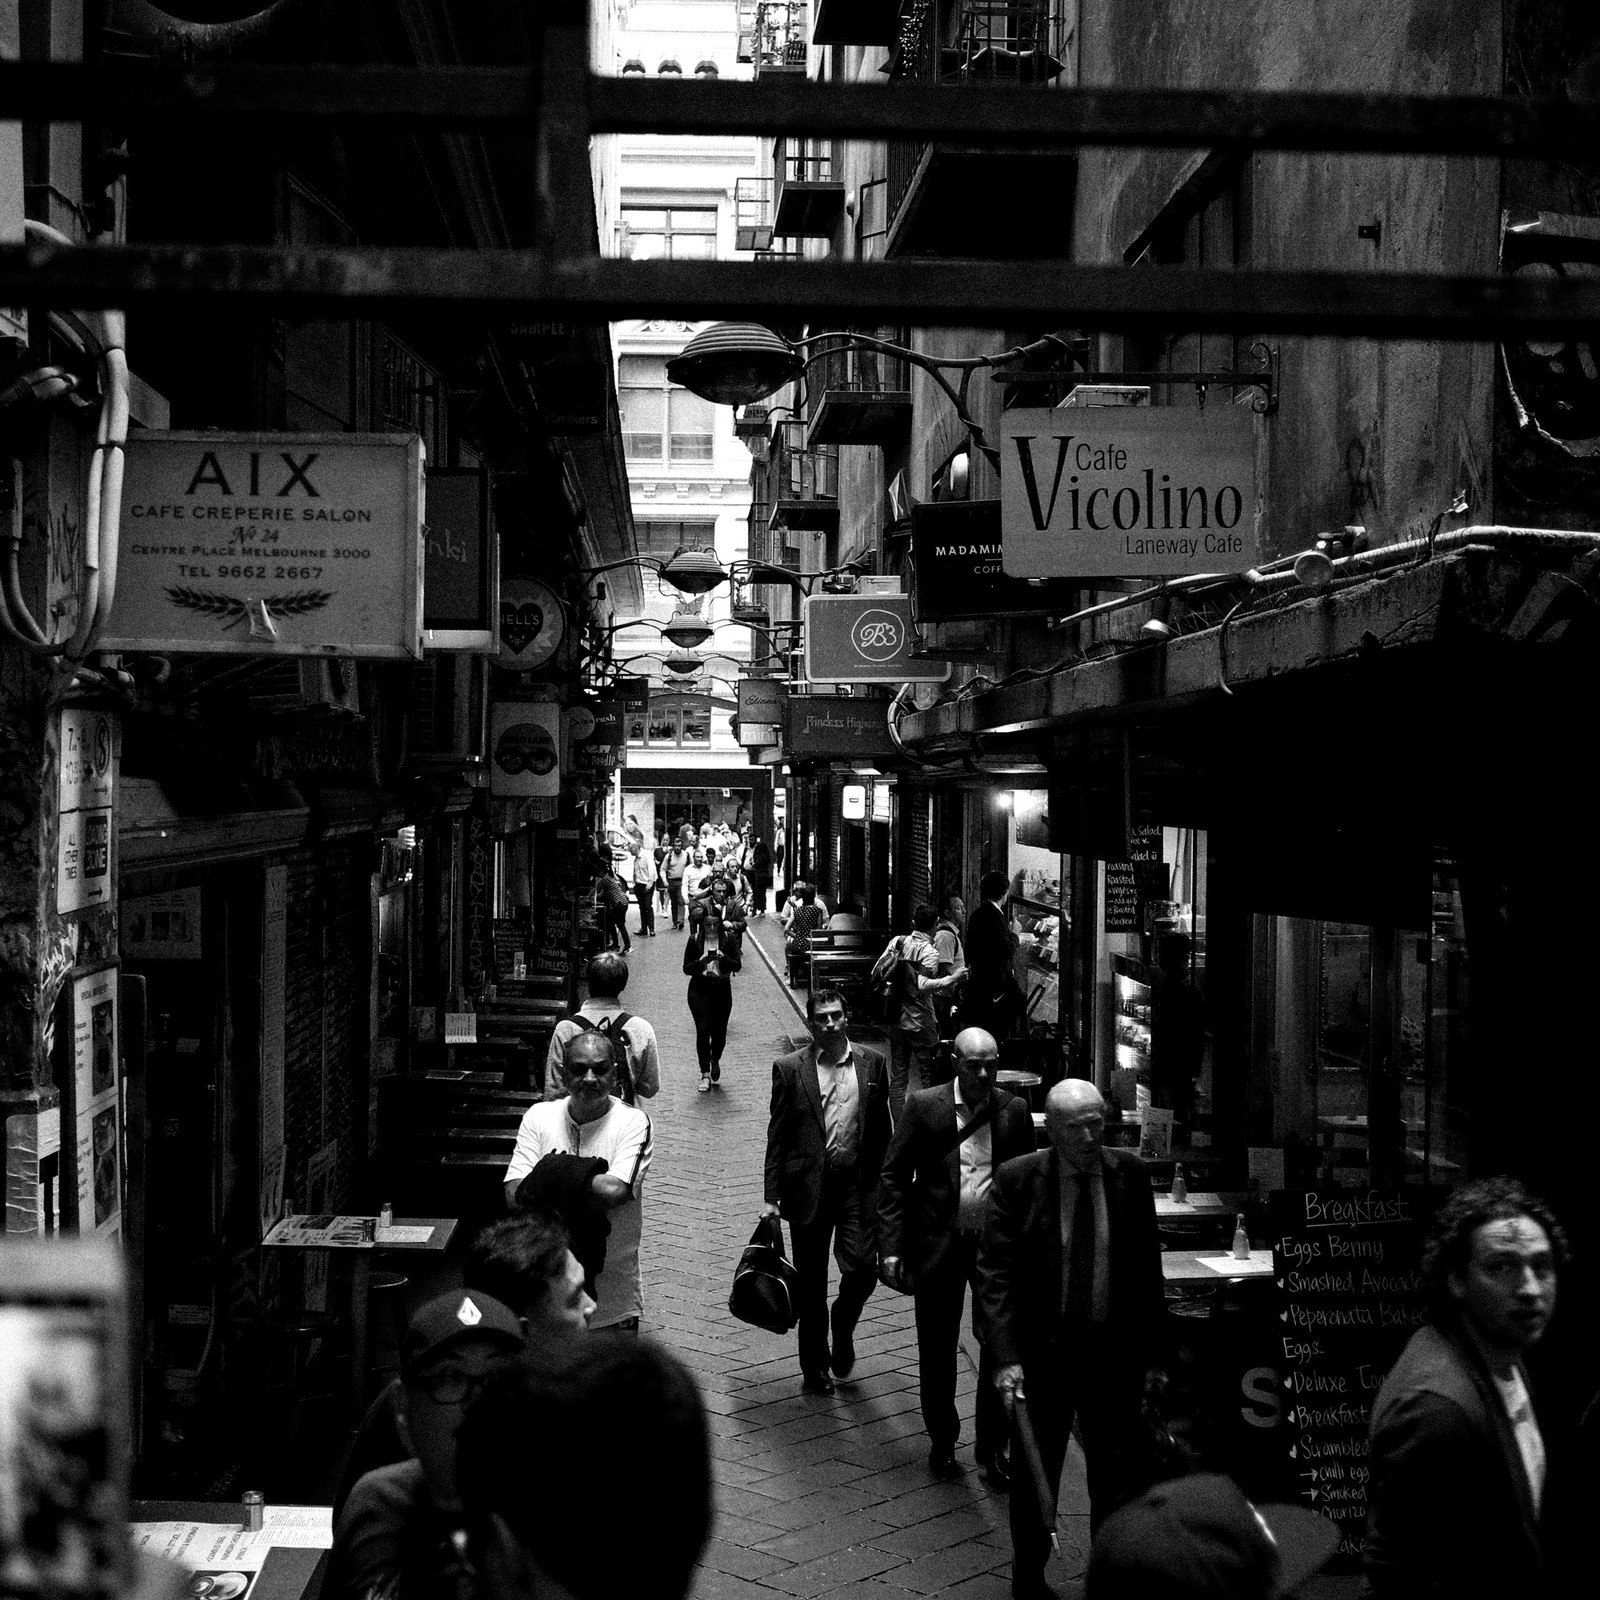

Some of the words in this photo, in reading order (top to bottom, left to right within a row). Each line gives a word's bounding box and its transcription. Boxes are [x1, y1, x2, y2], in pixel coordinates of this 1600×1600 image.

[1075, 443, 1127, 471] Cafe
[185, 451, 321, 498] AIX
[1010, 435, 1242, 531] Vicolino
[131, 505, 185, 519] CAFE
[192, 506, 295, 521] CREPERIE
[302, 508, 371, 523] SALON
[333, 549, 371, 559] 3000
[1126, 535, 1198, 557] Laneway
[1204, 533, 1242, 554] Cafe
[218, 566, 266, 579] 9662
[275, 567, 323, 579] 2667
[1305, 1189, 1409, 1222] Breakfast
[1281, 1236, 1322, 1268] Eggs
[1327, 1233, 1384, 1264] Benny
[1288, 1271, 1355, 1293] Smashed
[1290, 1303, 1373, 1333] Peperonata
[1293, 1368, 1347, 1394] Deluxe
[1241, 1366, 1282, 1428] S
[1296, 1402, 1369, 1429] Breakfast
[1300, 1434, 1369, 1459] Scrambled
[1320, 1483, 1368, 1502] Smoked
